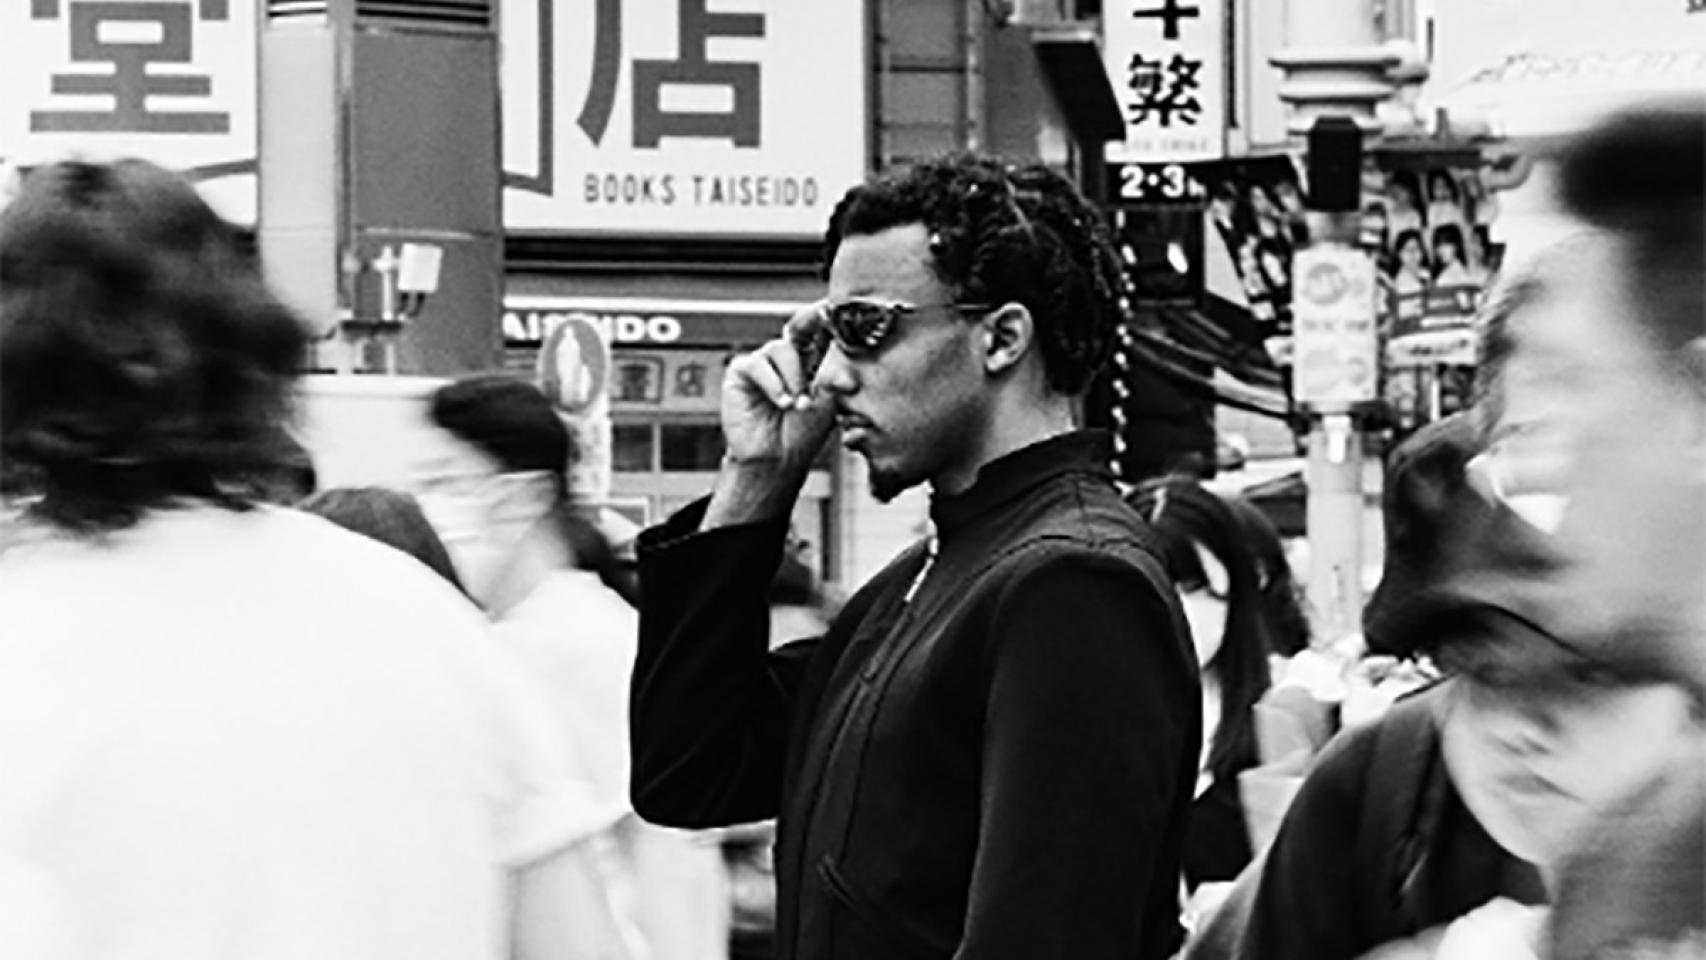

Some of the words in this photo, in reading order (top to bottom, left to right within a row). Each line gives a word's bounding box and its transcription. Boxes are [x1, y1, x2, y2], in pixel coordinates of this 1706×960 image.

[577, 0, 766, 149] 店
[584, 174, 676, 205] BOOKS
[693, 175, 818, 206] TAISEIDO
